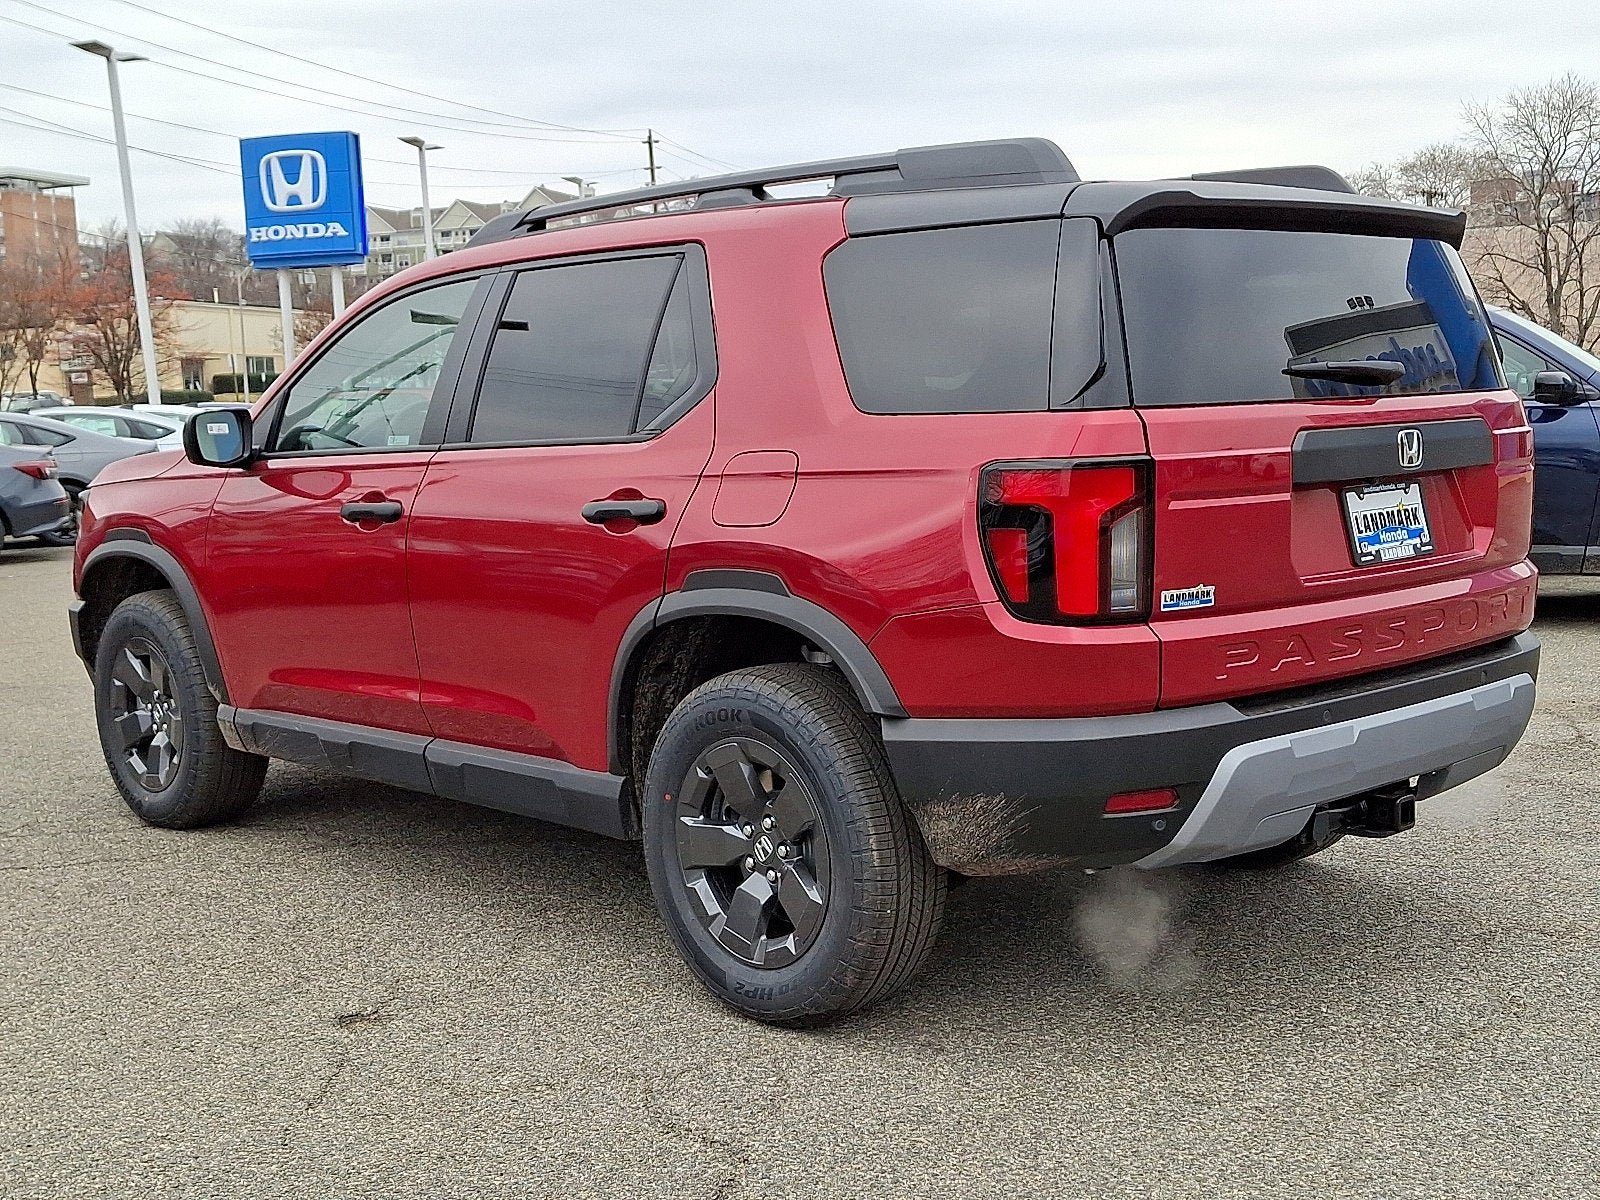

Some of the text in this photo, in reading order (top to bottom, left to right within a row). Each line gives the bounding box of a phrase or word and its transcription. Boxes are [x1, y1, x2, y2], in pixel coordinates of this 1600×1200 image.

[249, 222, 349, 243] HONDA
[1354, 506, 1421, 535] LANDMARK
[1379, 528, 1409, 544] Honda
[1380, 544, 1415, 560] LANDMARK
[1163, 589, 1212, 603] LANDMARK
[1179, 599, 1201, 607] Honda
[1215, 586, 1531, 680] PASSPORT
